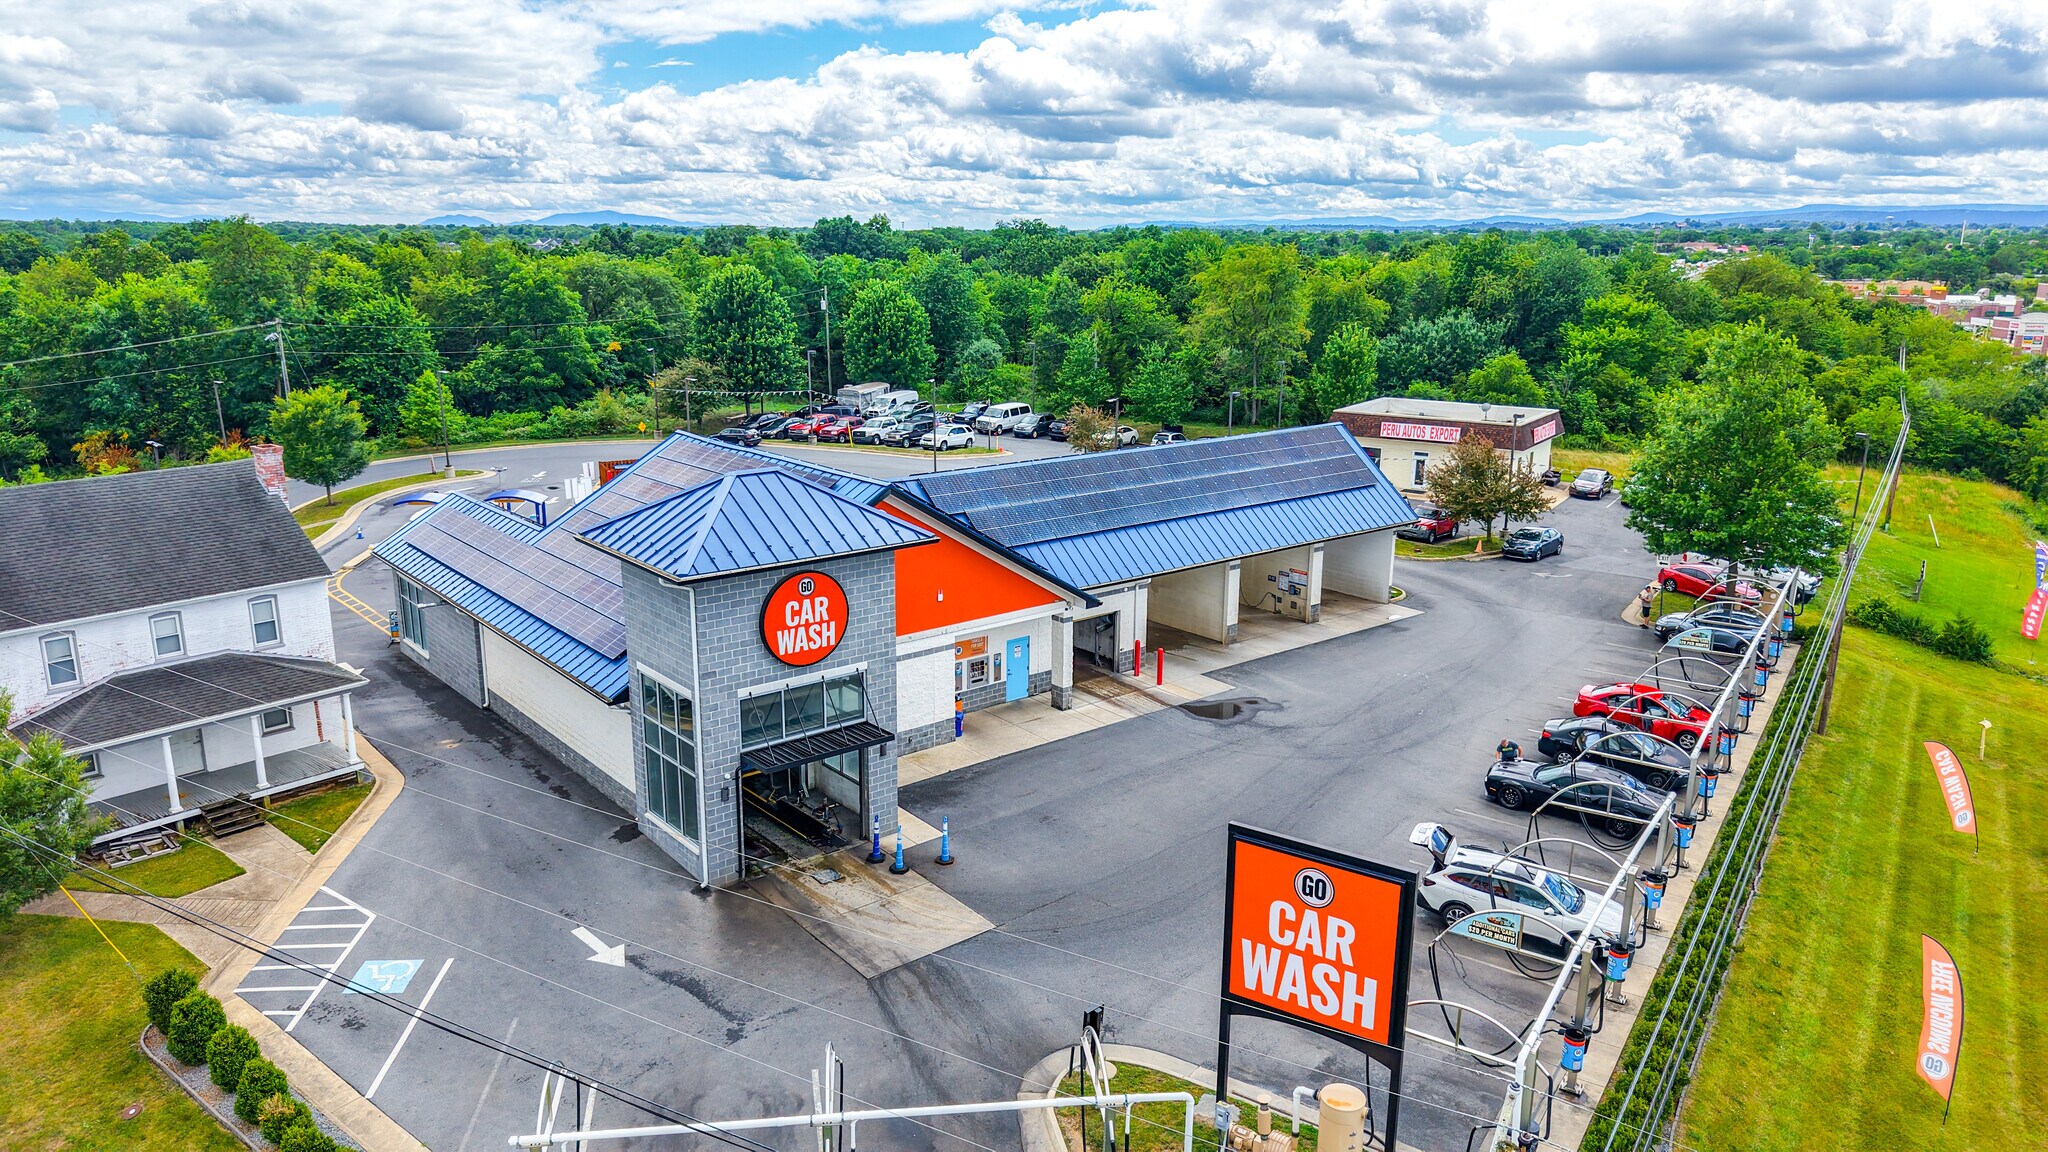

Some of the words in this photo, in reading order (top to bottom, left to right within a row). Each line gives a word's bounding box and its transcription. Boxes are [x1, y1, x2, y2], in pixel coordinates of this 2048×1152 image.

[1382, 423, 1400, 437] PERU
[1402, 425, 1426, 438] AUTOS
[1430, 427, 1459, 441] EXPORT
[801, 580, 812, 593] GO
[785, 597, 829, 627] CAR
[777, 621, 836, 656] WASH
[1301, 874, 1327, 901] GO
[1268, 900, 1356, 967] CAR
[1469, 925, 1480, 934] $20
[1481, 929, 1493, 938] PER
[1494, 932, 1515, 944] MONTH
[1241, 938, 1378, 1030] WASH
